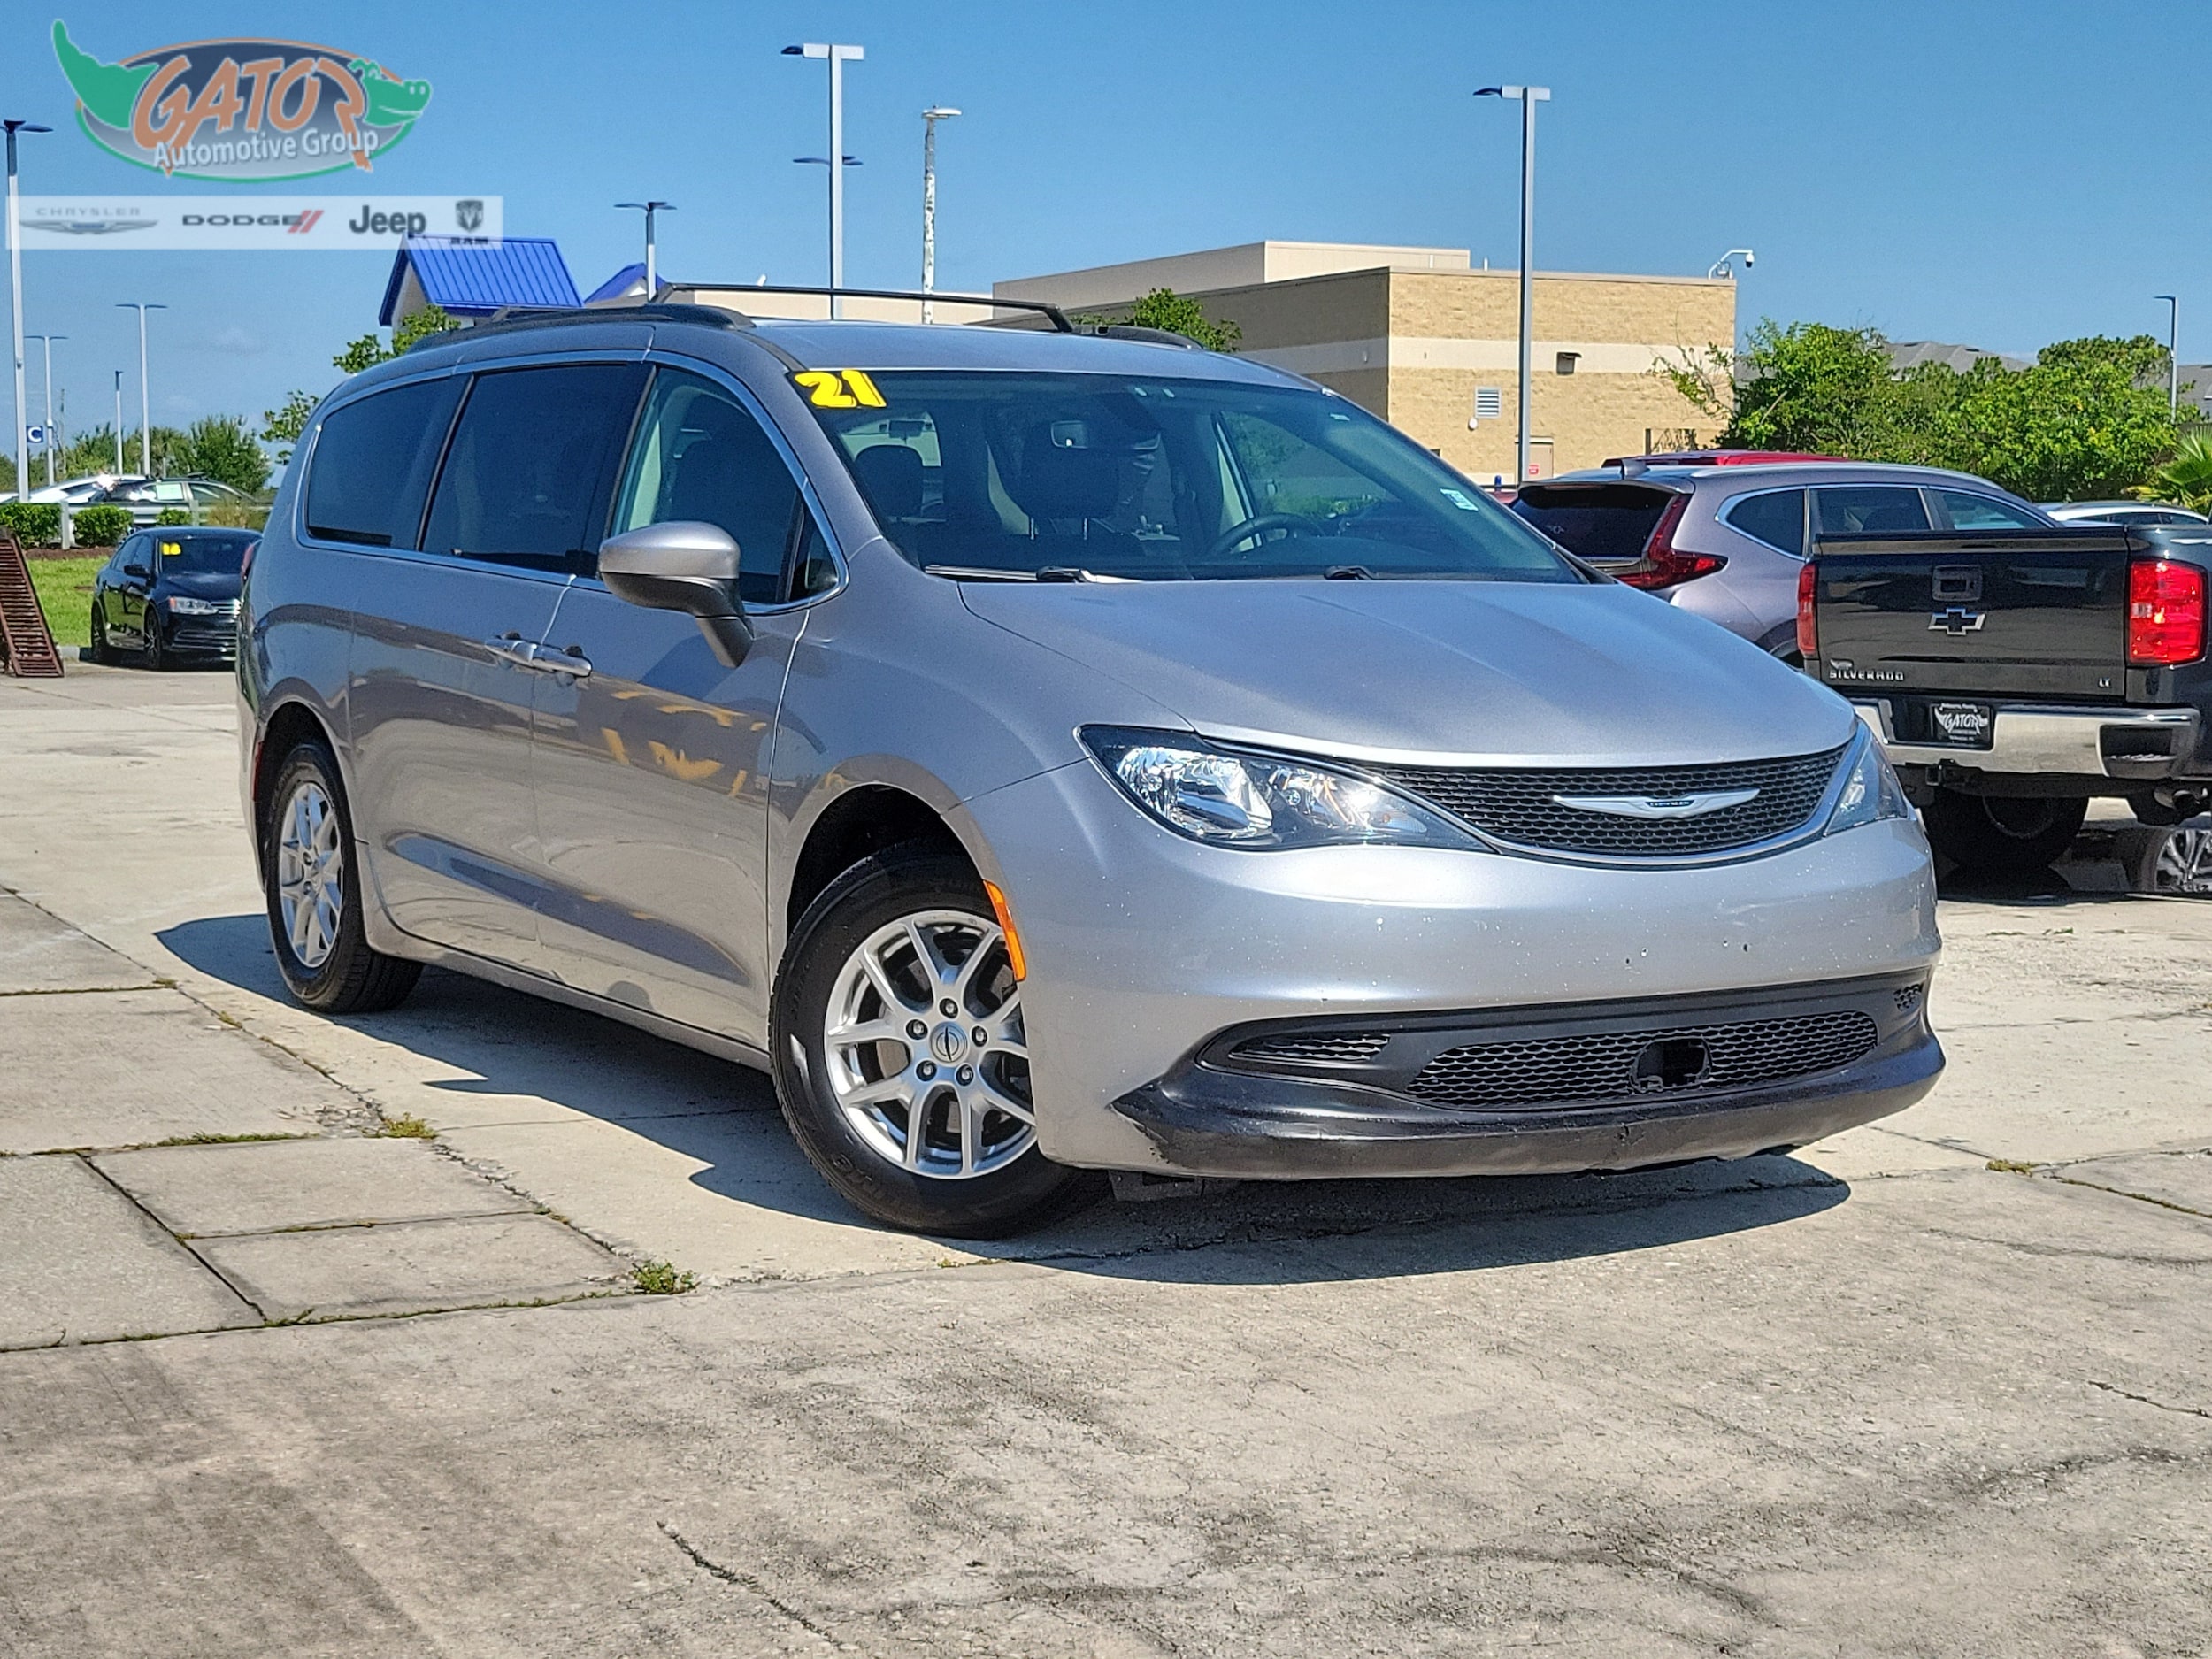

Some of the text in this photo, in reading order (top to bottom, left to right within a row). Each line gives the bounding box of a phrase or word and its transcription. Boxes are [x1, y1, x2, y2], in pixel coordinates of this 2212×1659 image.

[795, 369, 887, 408] 21
[28, 426, 42, 442] C
[1829, 669, 1905, 680] SILVERADO
[1944, 713, 1981, 734] GATOR
